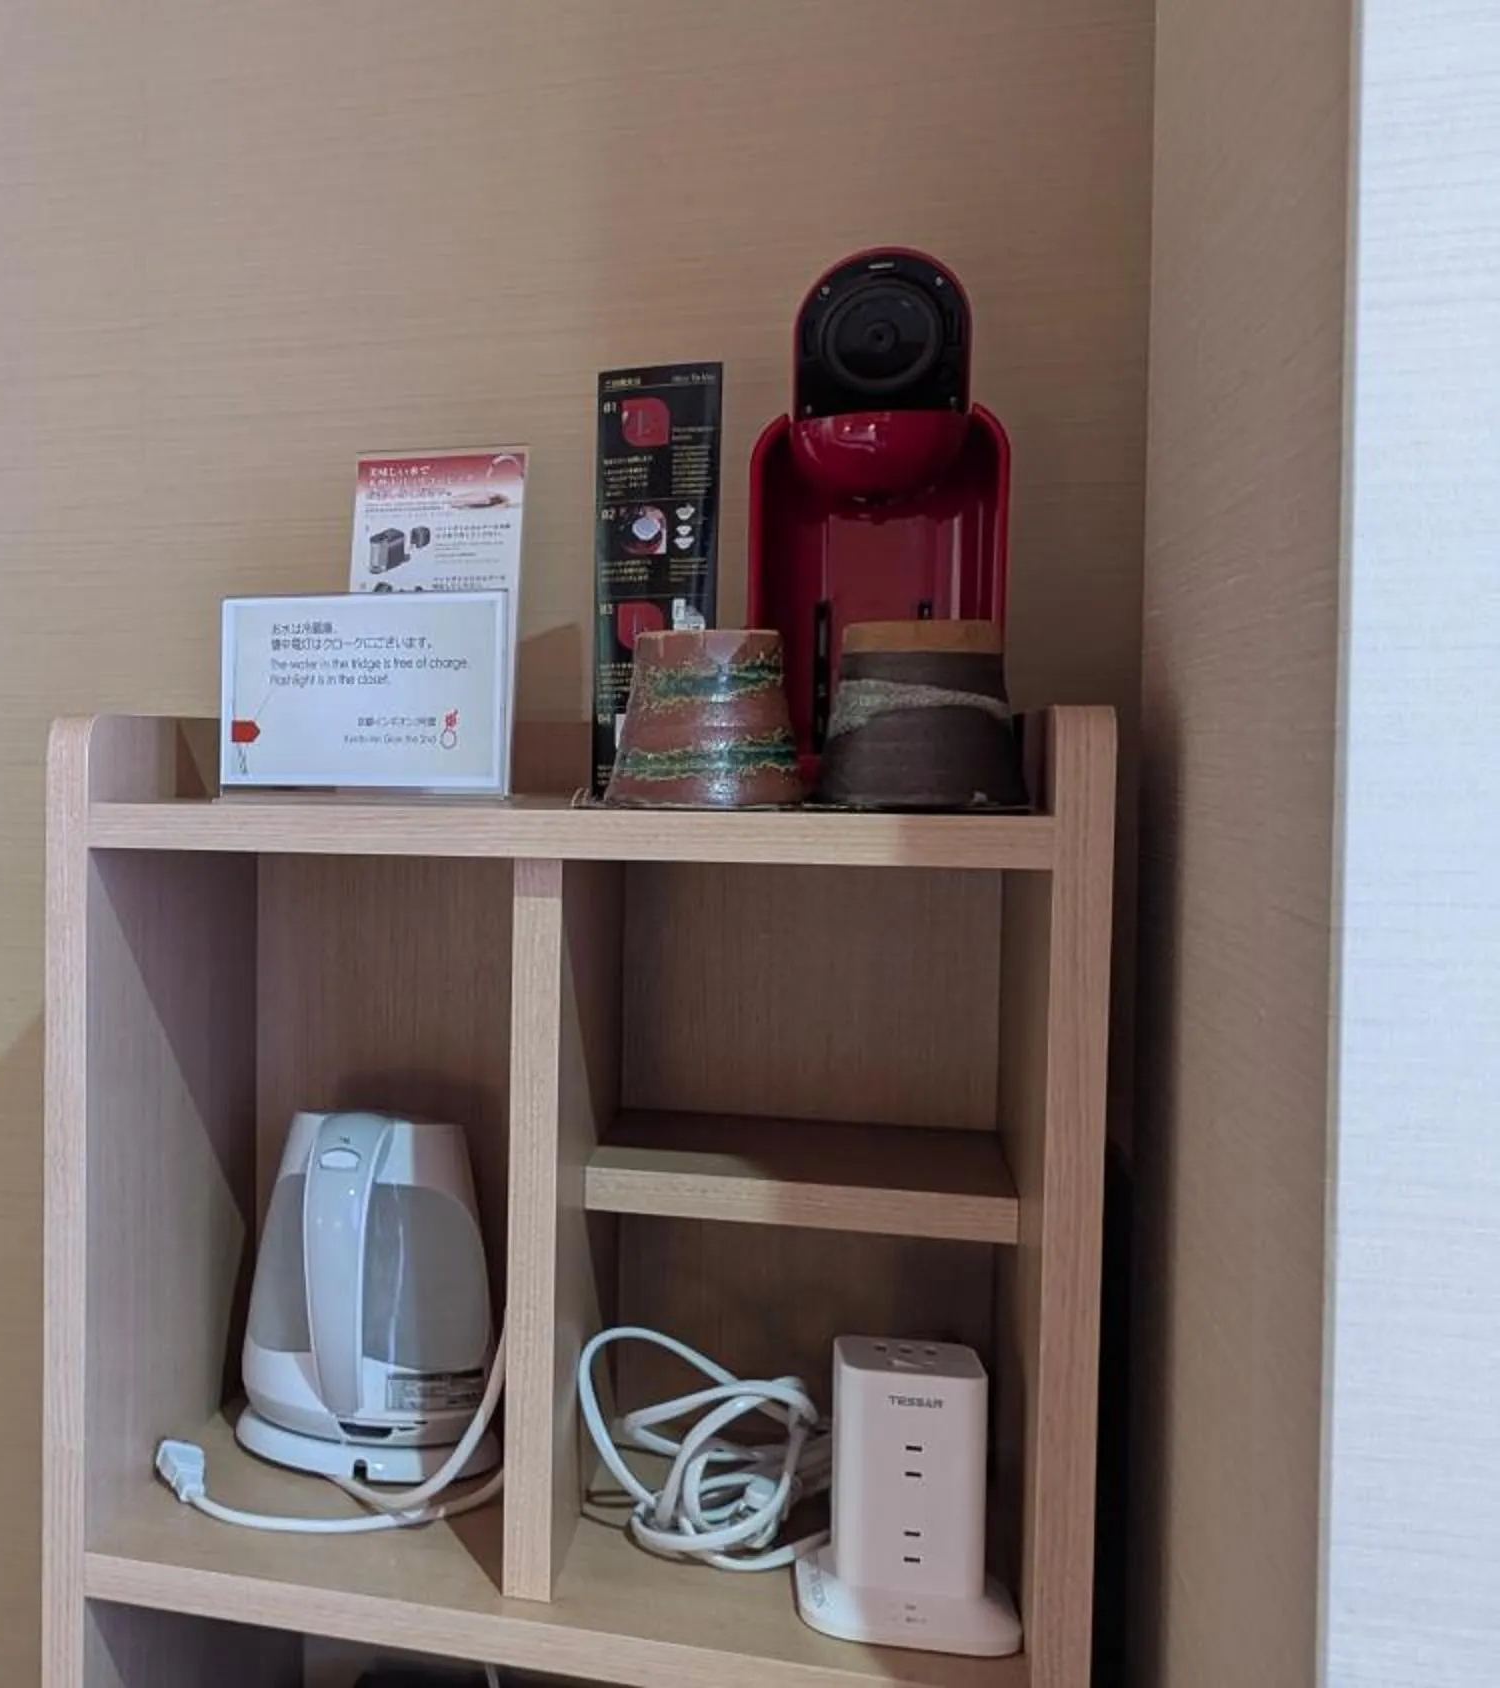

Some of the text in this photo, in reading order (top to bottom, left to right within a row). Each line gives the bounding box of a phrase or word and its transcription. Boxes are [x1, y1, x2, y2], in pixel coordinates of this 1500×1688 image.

[332, 657, 348, 668] the
[351, 657, 381, 672] fridge
[383, 657, 391, 668] is
[393, 657, 413, 669] free
[416, 657, 427, 669] of
[326, 674, 337, 685] in
[339, 673, 356, 685] the
